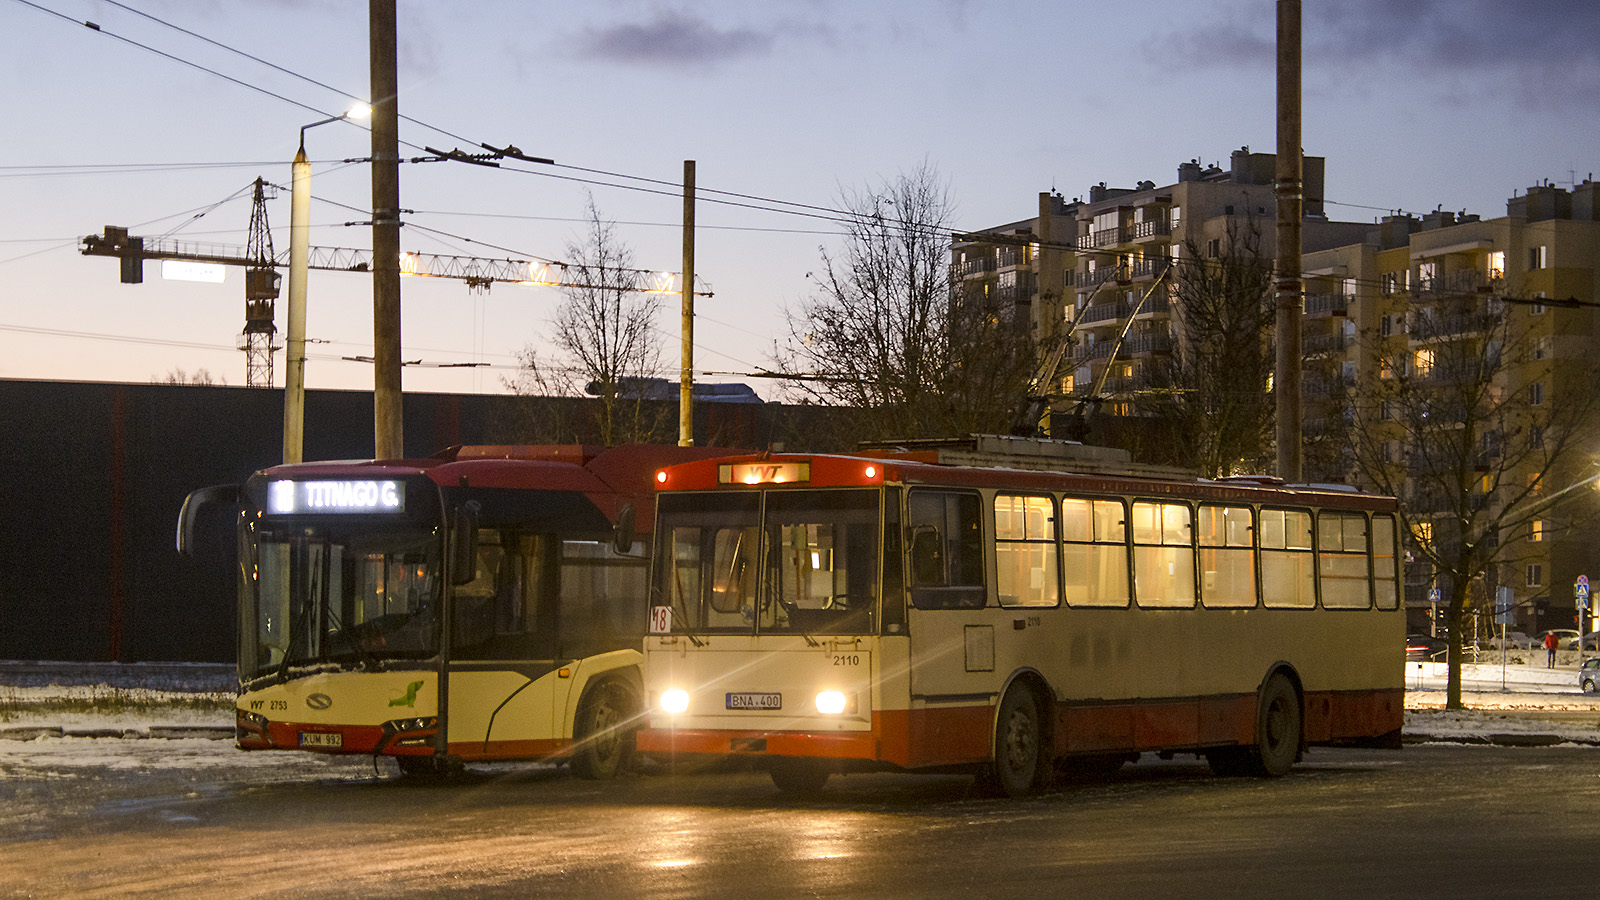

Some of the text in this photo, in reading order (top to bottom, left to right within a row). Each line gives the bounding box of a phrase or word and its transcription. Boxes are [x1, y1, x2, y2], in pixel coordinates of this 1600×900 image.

[750, 465, 783, 479] VVT
[305, 481, 378, 507] TITNAGO
[381, 481, 399, 506] G.
[655, 609, 667, 631] 18
[833, 655, 860, 666] 2110
[250, 700, 288, 711] VVT 2753
[732, 695, 779, 707] BNA 400
[304, 734, 341, 745] KUM 992
